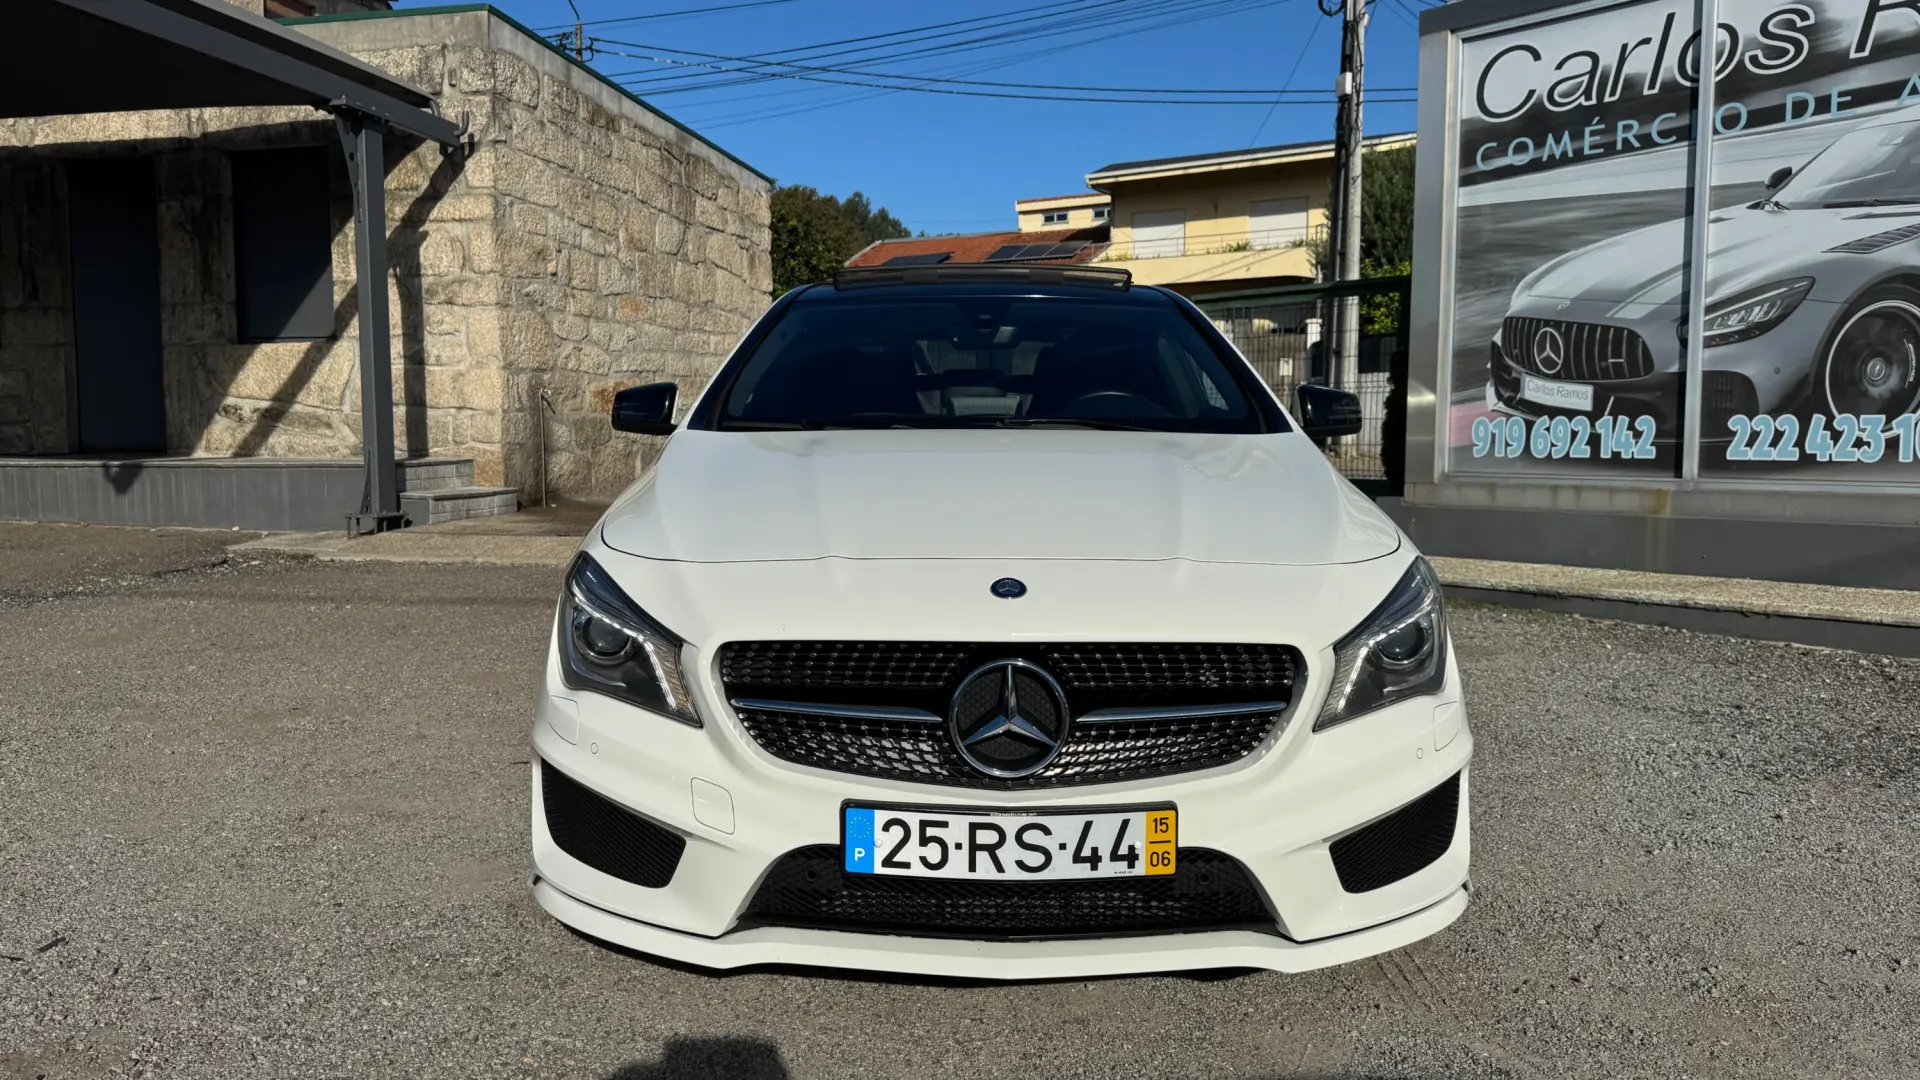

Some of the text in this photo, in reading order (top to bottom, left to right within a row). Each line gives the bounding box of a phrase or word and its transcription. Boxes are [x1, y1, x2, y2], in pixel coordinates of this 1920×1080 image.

[1476, 4, 1816, 122] Carlos
[1785, 85, 1856, 125] DE
[1527, 379, 1589, 400] Carlos Ramos
[1472, 415, 1656, 459] 919 692 142
[1726, 413, 1920, 463] 222 423 1
[1152, 816, 1170, 834] 15
[854, 847, 866, 861] P
[1149, 851, 1172, 868] 06
